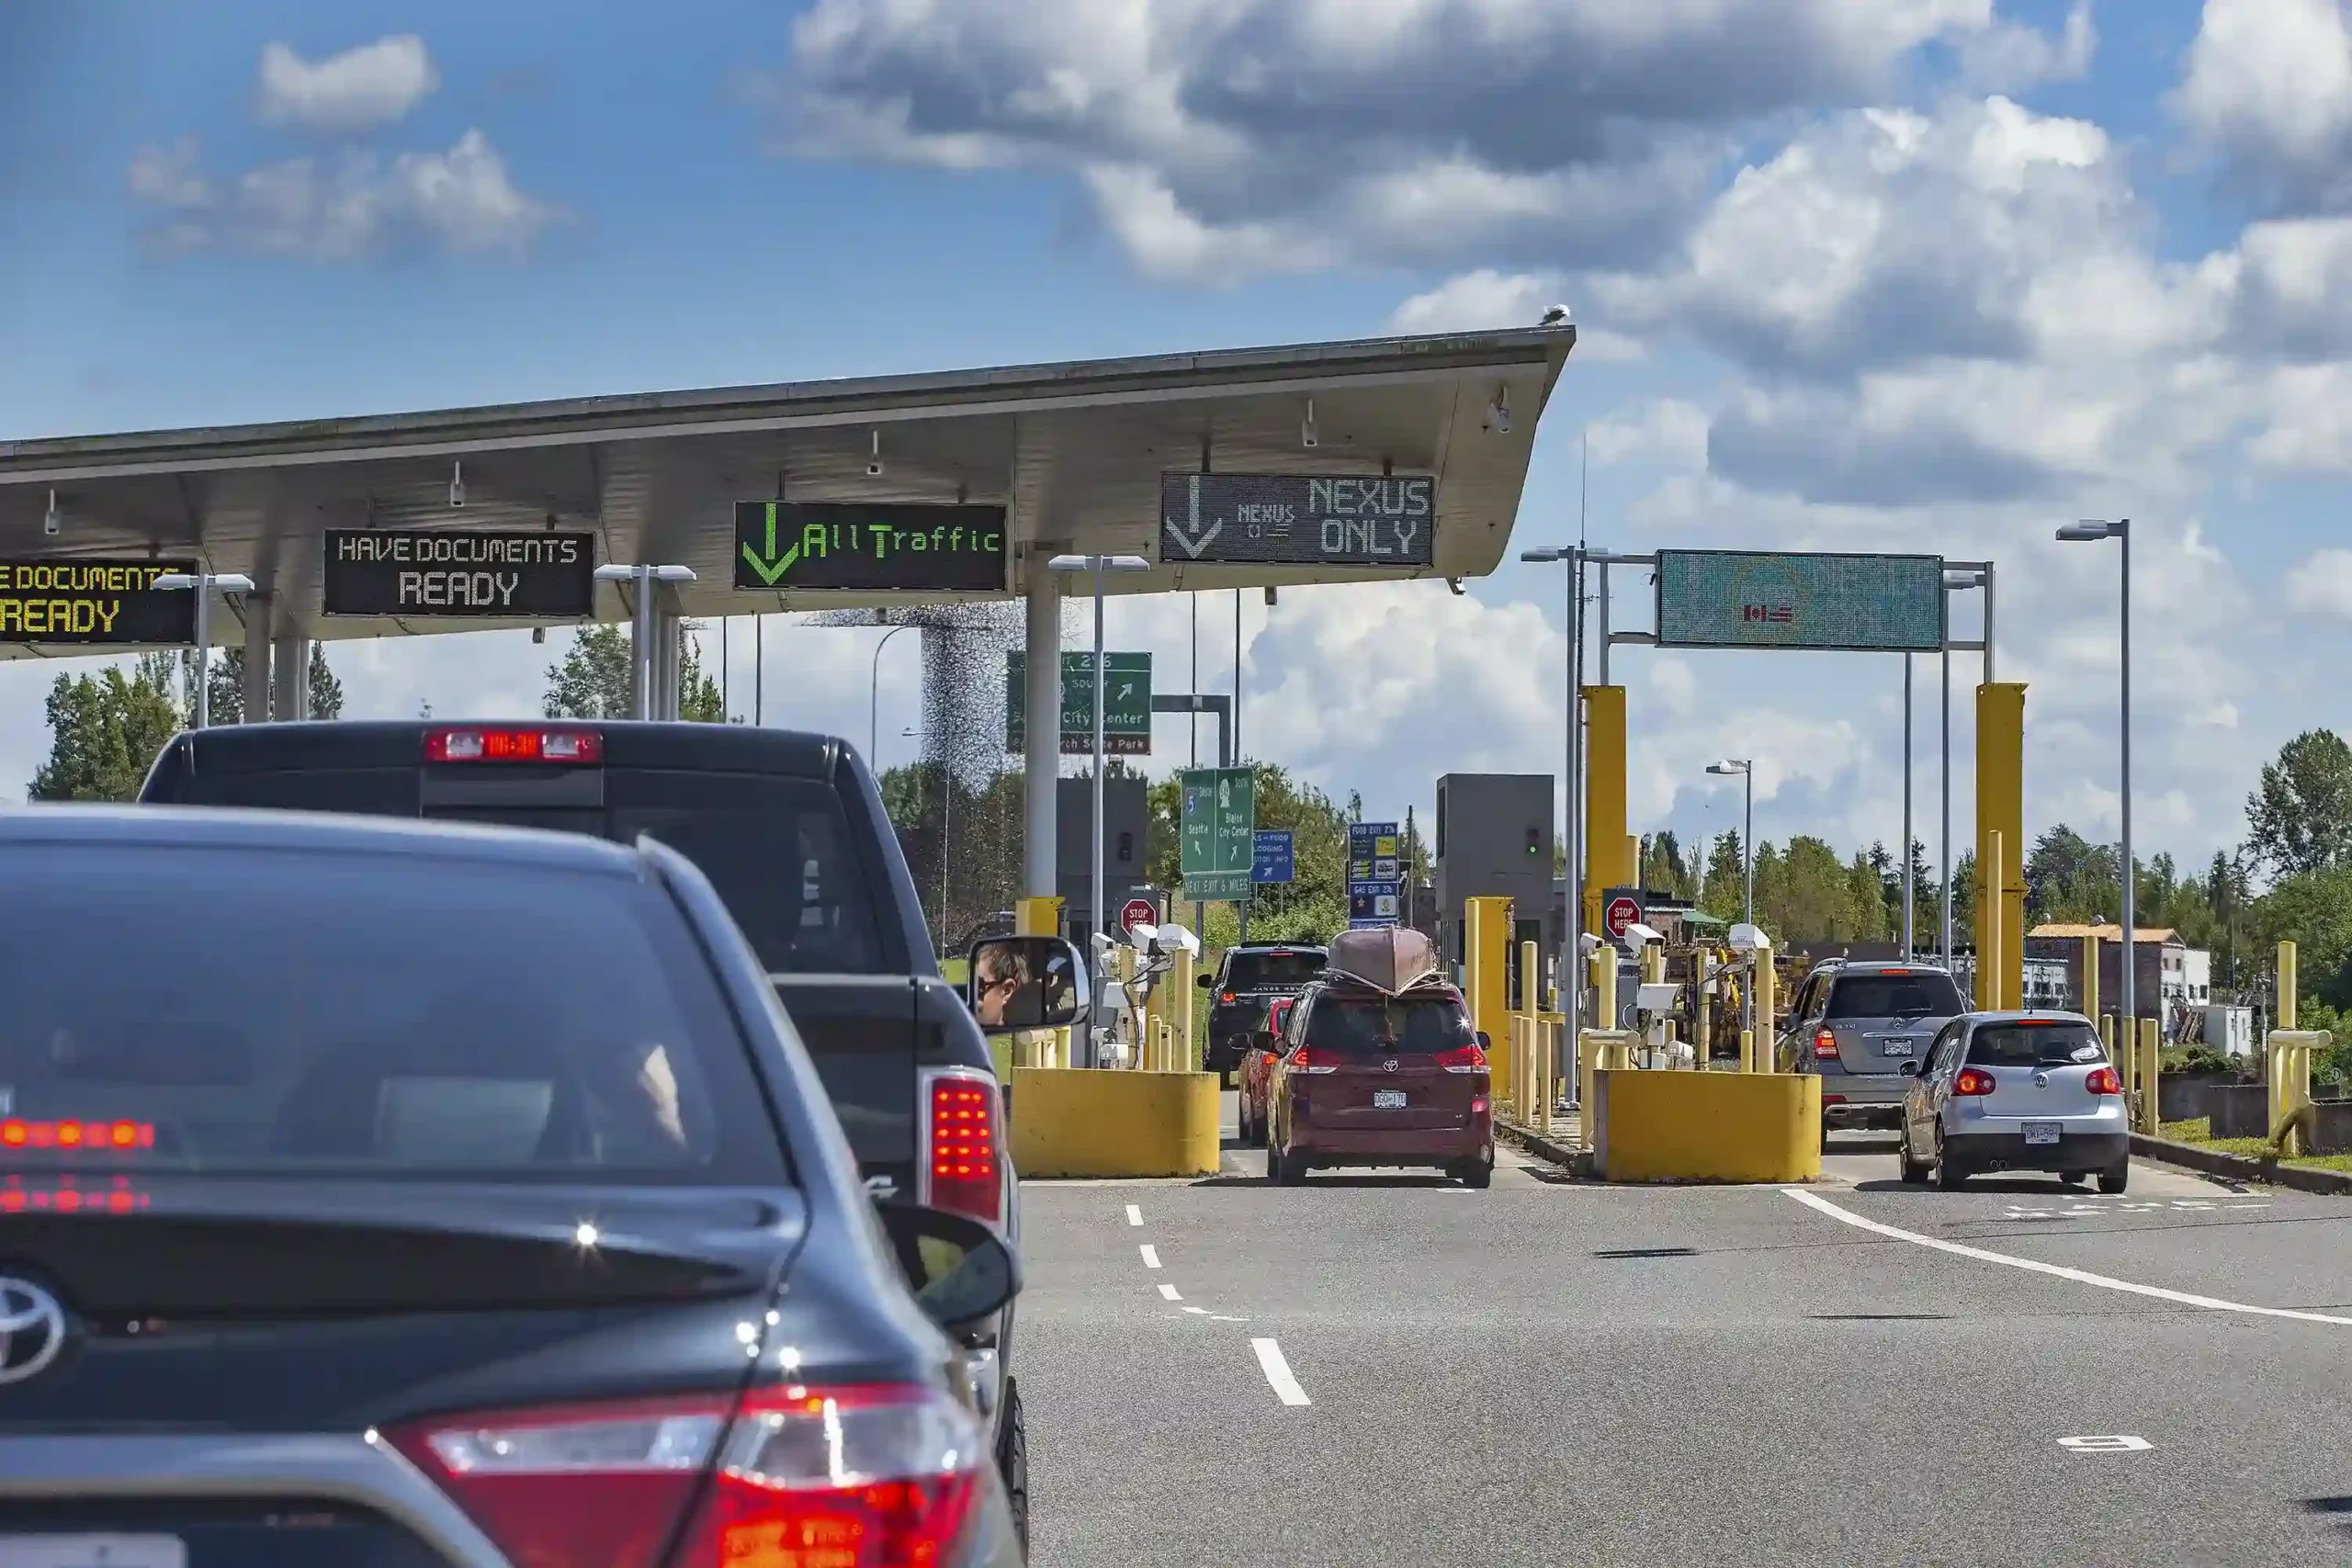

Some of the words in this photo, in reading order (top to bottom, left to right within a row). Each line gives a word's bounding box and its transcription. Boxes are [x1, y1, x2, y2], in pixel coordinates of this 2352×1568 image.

[1309, 479, 1429, 515] NEXUS
[802, 524, 859, 558] All
[868, 525, 1000, 558] Traffic
[1320, 519, 1417, 554] ONLY
[338, 536, 411, 561] HAVE
[415, 537, 577, 563] DOCUMENTS
[400, 571, 518, 604] READY
[0, 599, 119, 633] READY
[1081, 654, 1112, 669] 26
[1062, 712, 1091, 727] City
[1102, 712, 1144, 725] enter
[1117, 738, 1145, 749] Park
[1185, 880, 1199, 894] NEXT
[1204, 879, 1217, 893] EXIT
[1229, 878, 1249, 891] MILES
[1128, 908, 1148, 919] STOP
[1614, 907, 1634, 918] STOP
